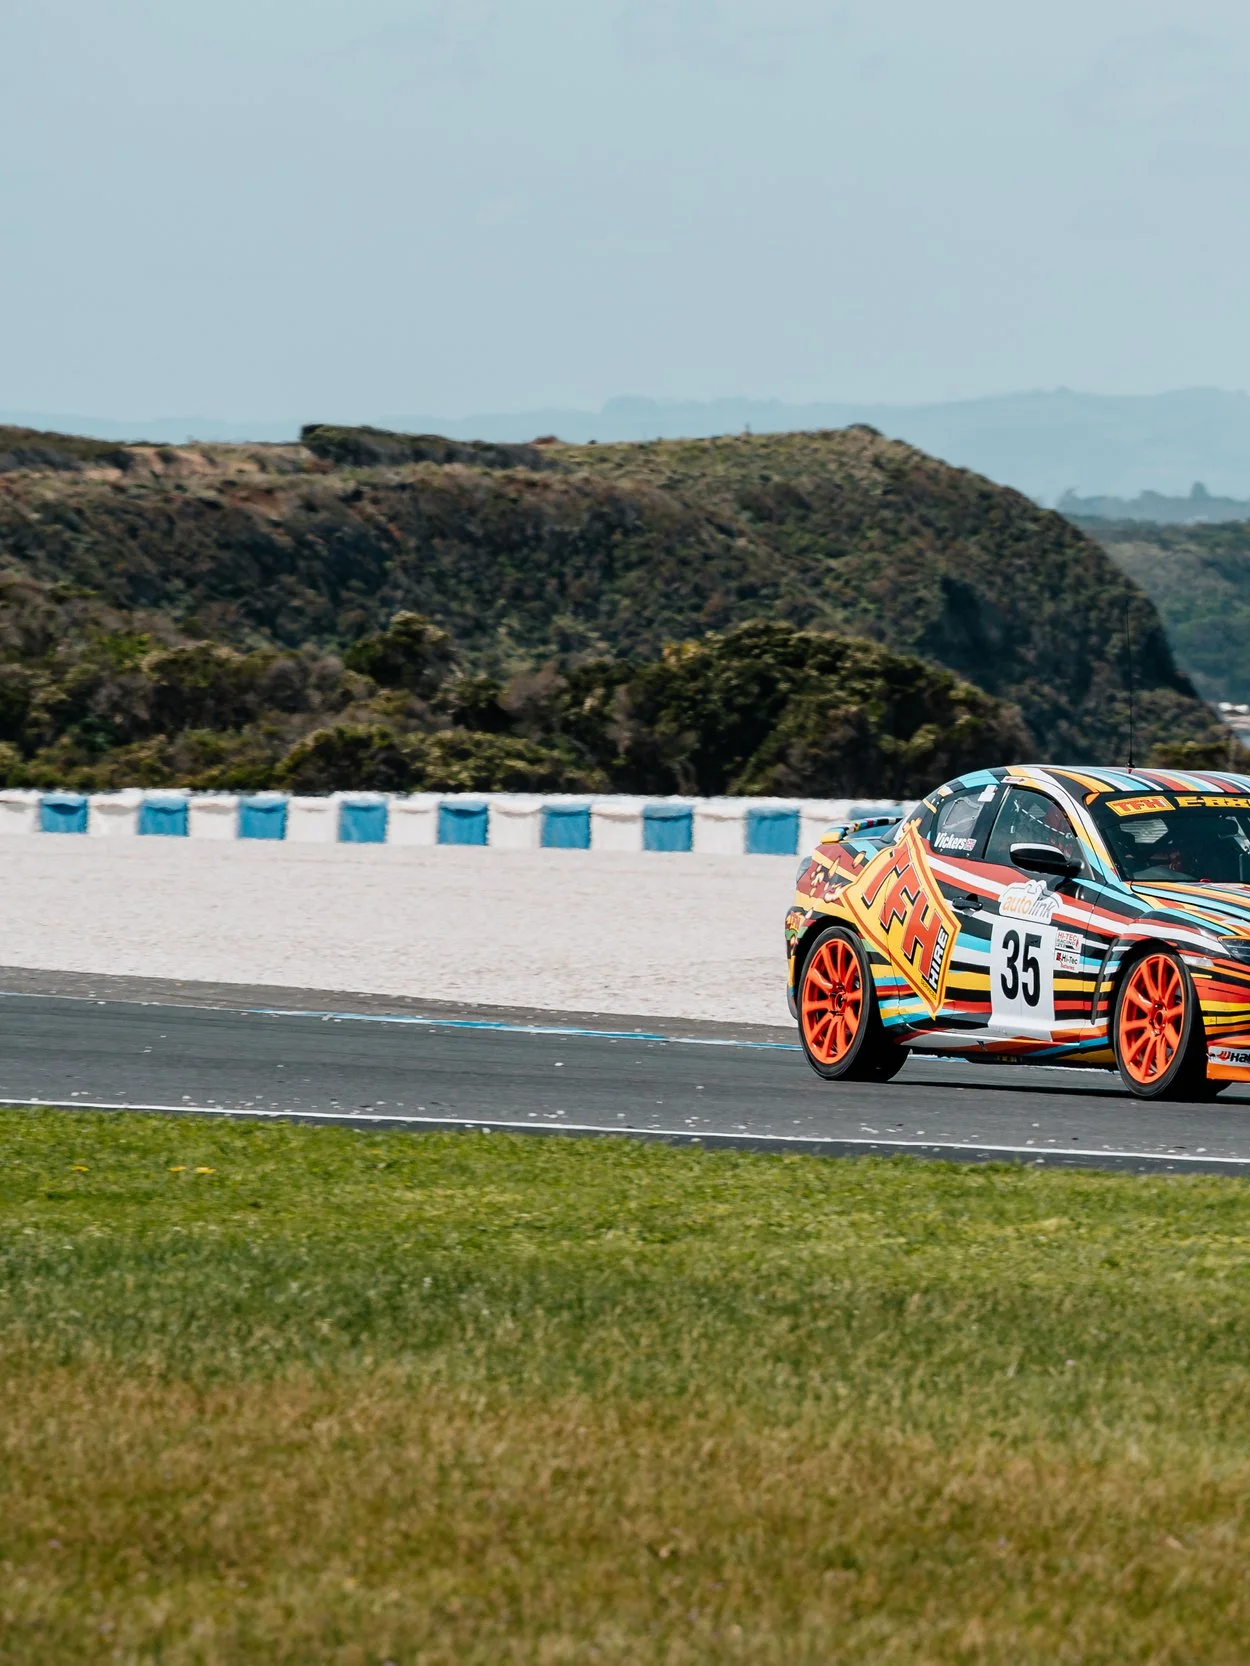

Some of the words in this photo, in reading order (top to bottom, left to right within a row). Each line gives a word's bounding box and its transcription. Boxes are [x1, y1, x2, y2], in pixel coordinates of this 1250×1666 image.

[1112, 798, 1165, 812] TFH
[934, 832, 967, 850] Vickers
[862, 839, 943, 981] TFH
[1002, 894, 1055, 919] autolink
[929, 928, 948, 990] HIRE
[1001, 929, 1042, 1007] 35
